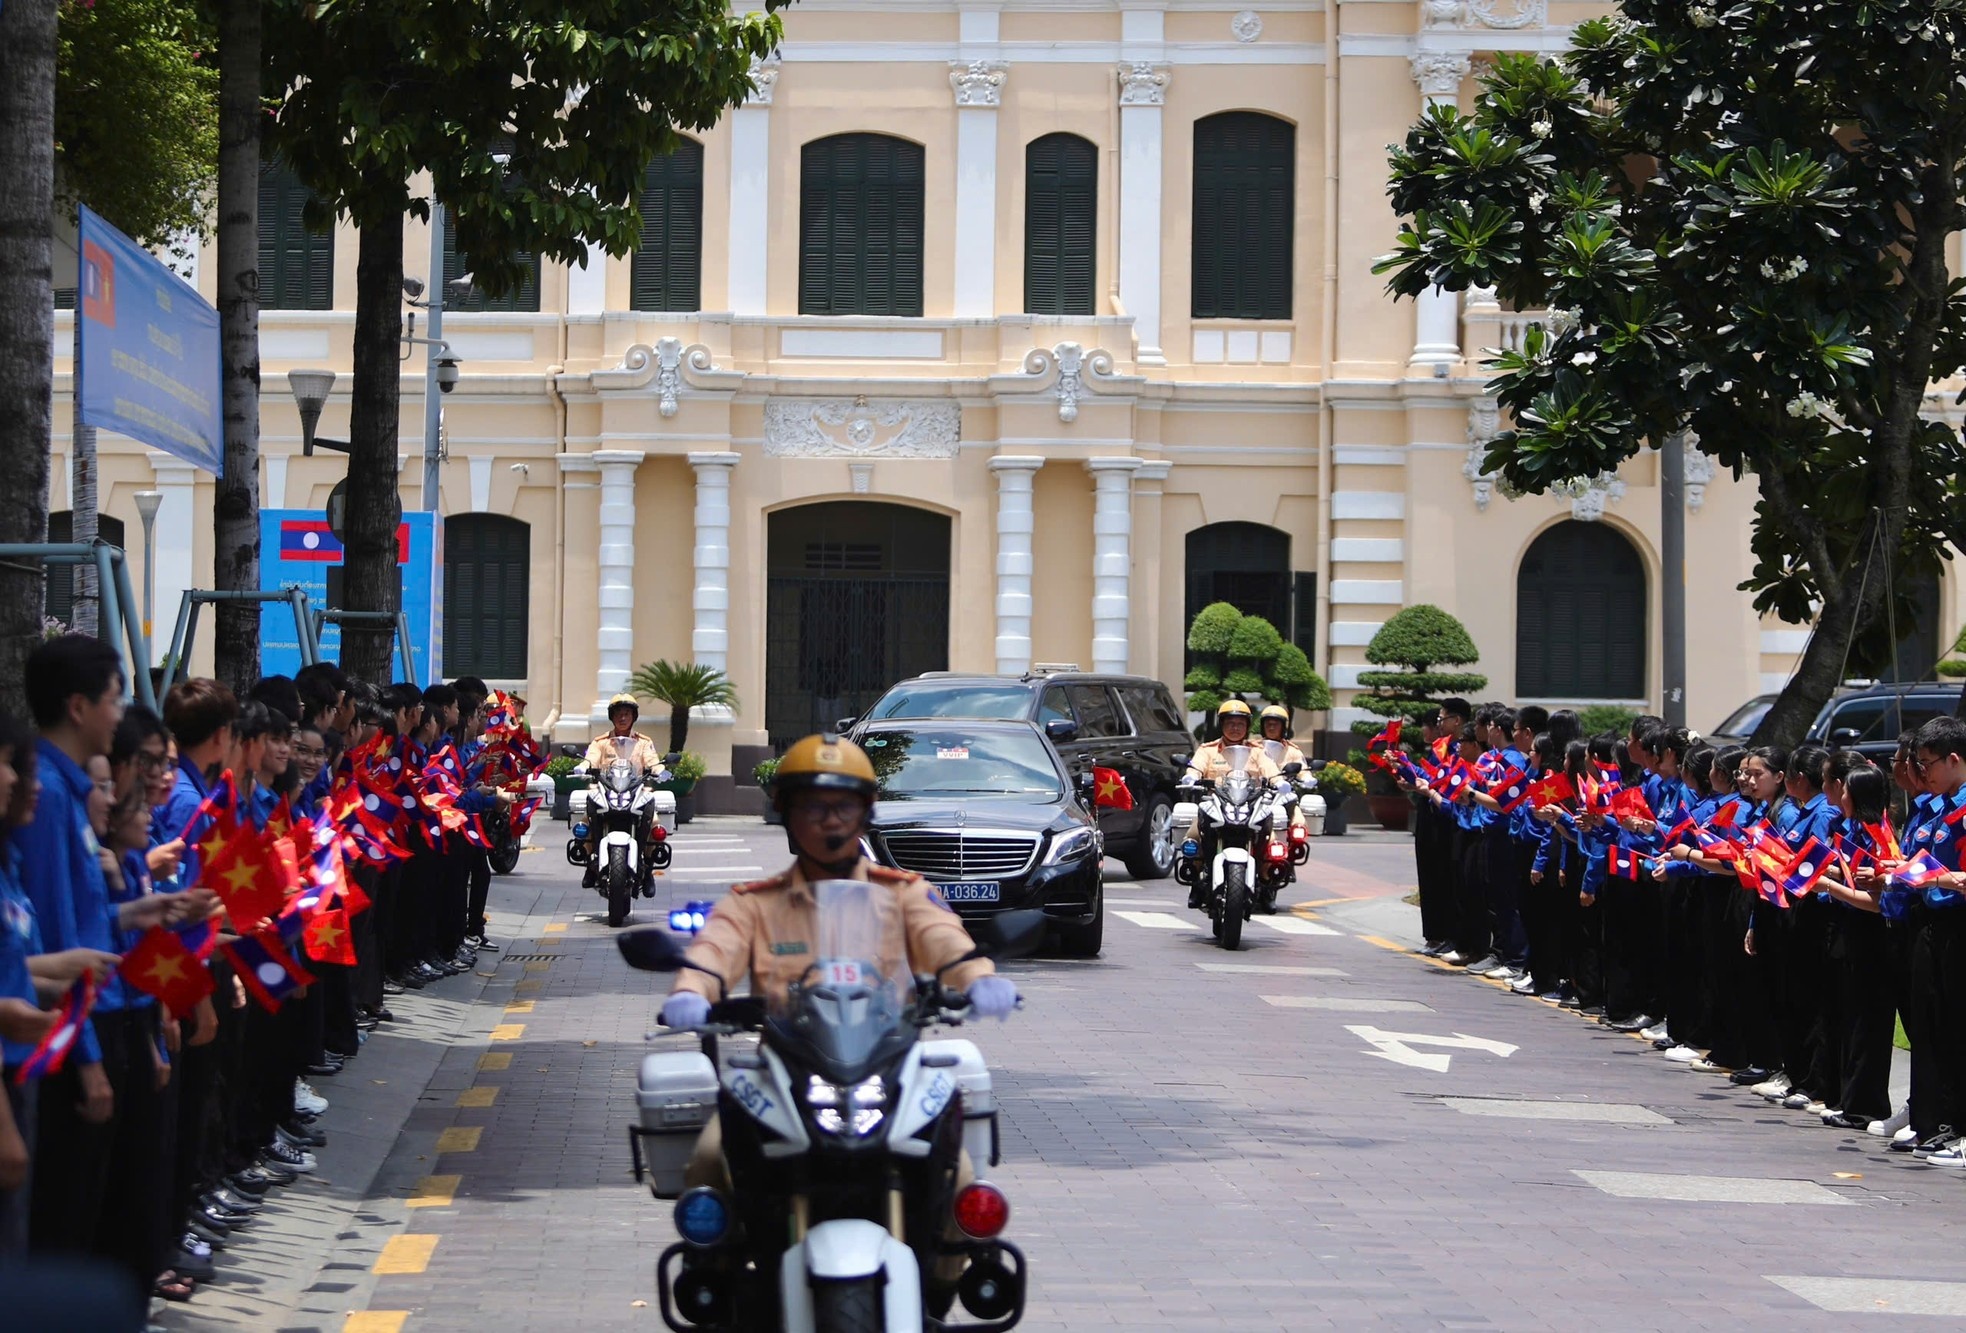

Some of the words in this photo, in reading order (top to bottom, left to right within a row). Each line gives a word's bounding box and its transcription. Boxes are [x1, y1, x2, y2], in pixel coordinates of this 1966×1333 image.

[834, 965, 857, 983] 15
[732, 1074, 774, 1117] CSGT
[919, 1072, 952, 1117] CSGT
